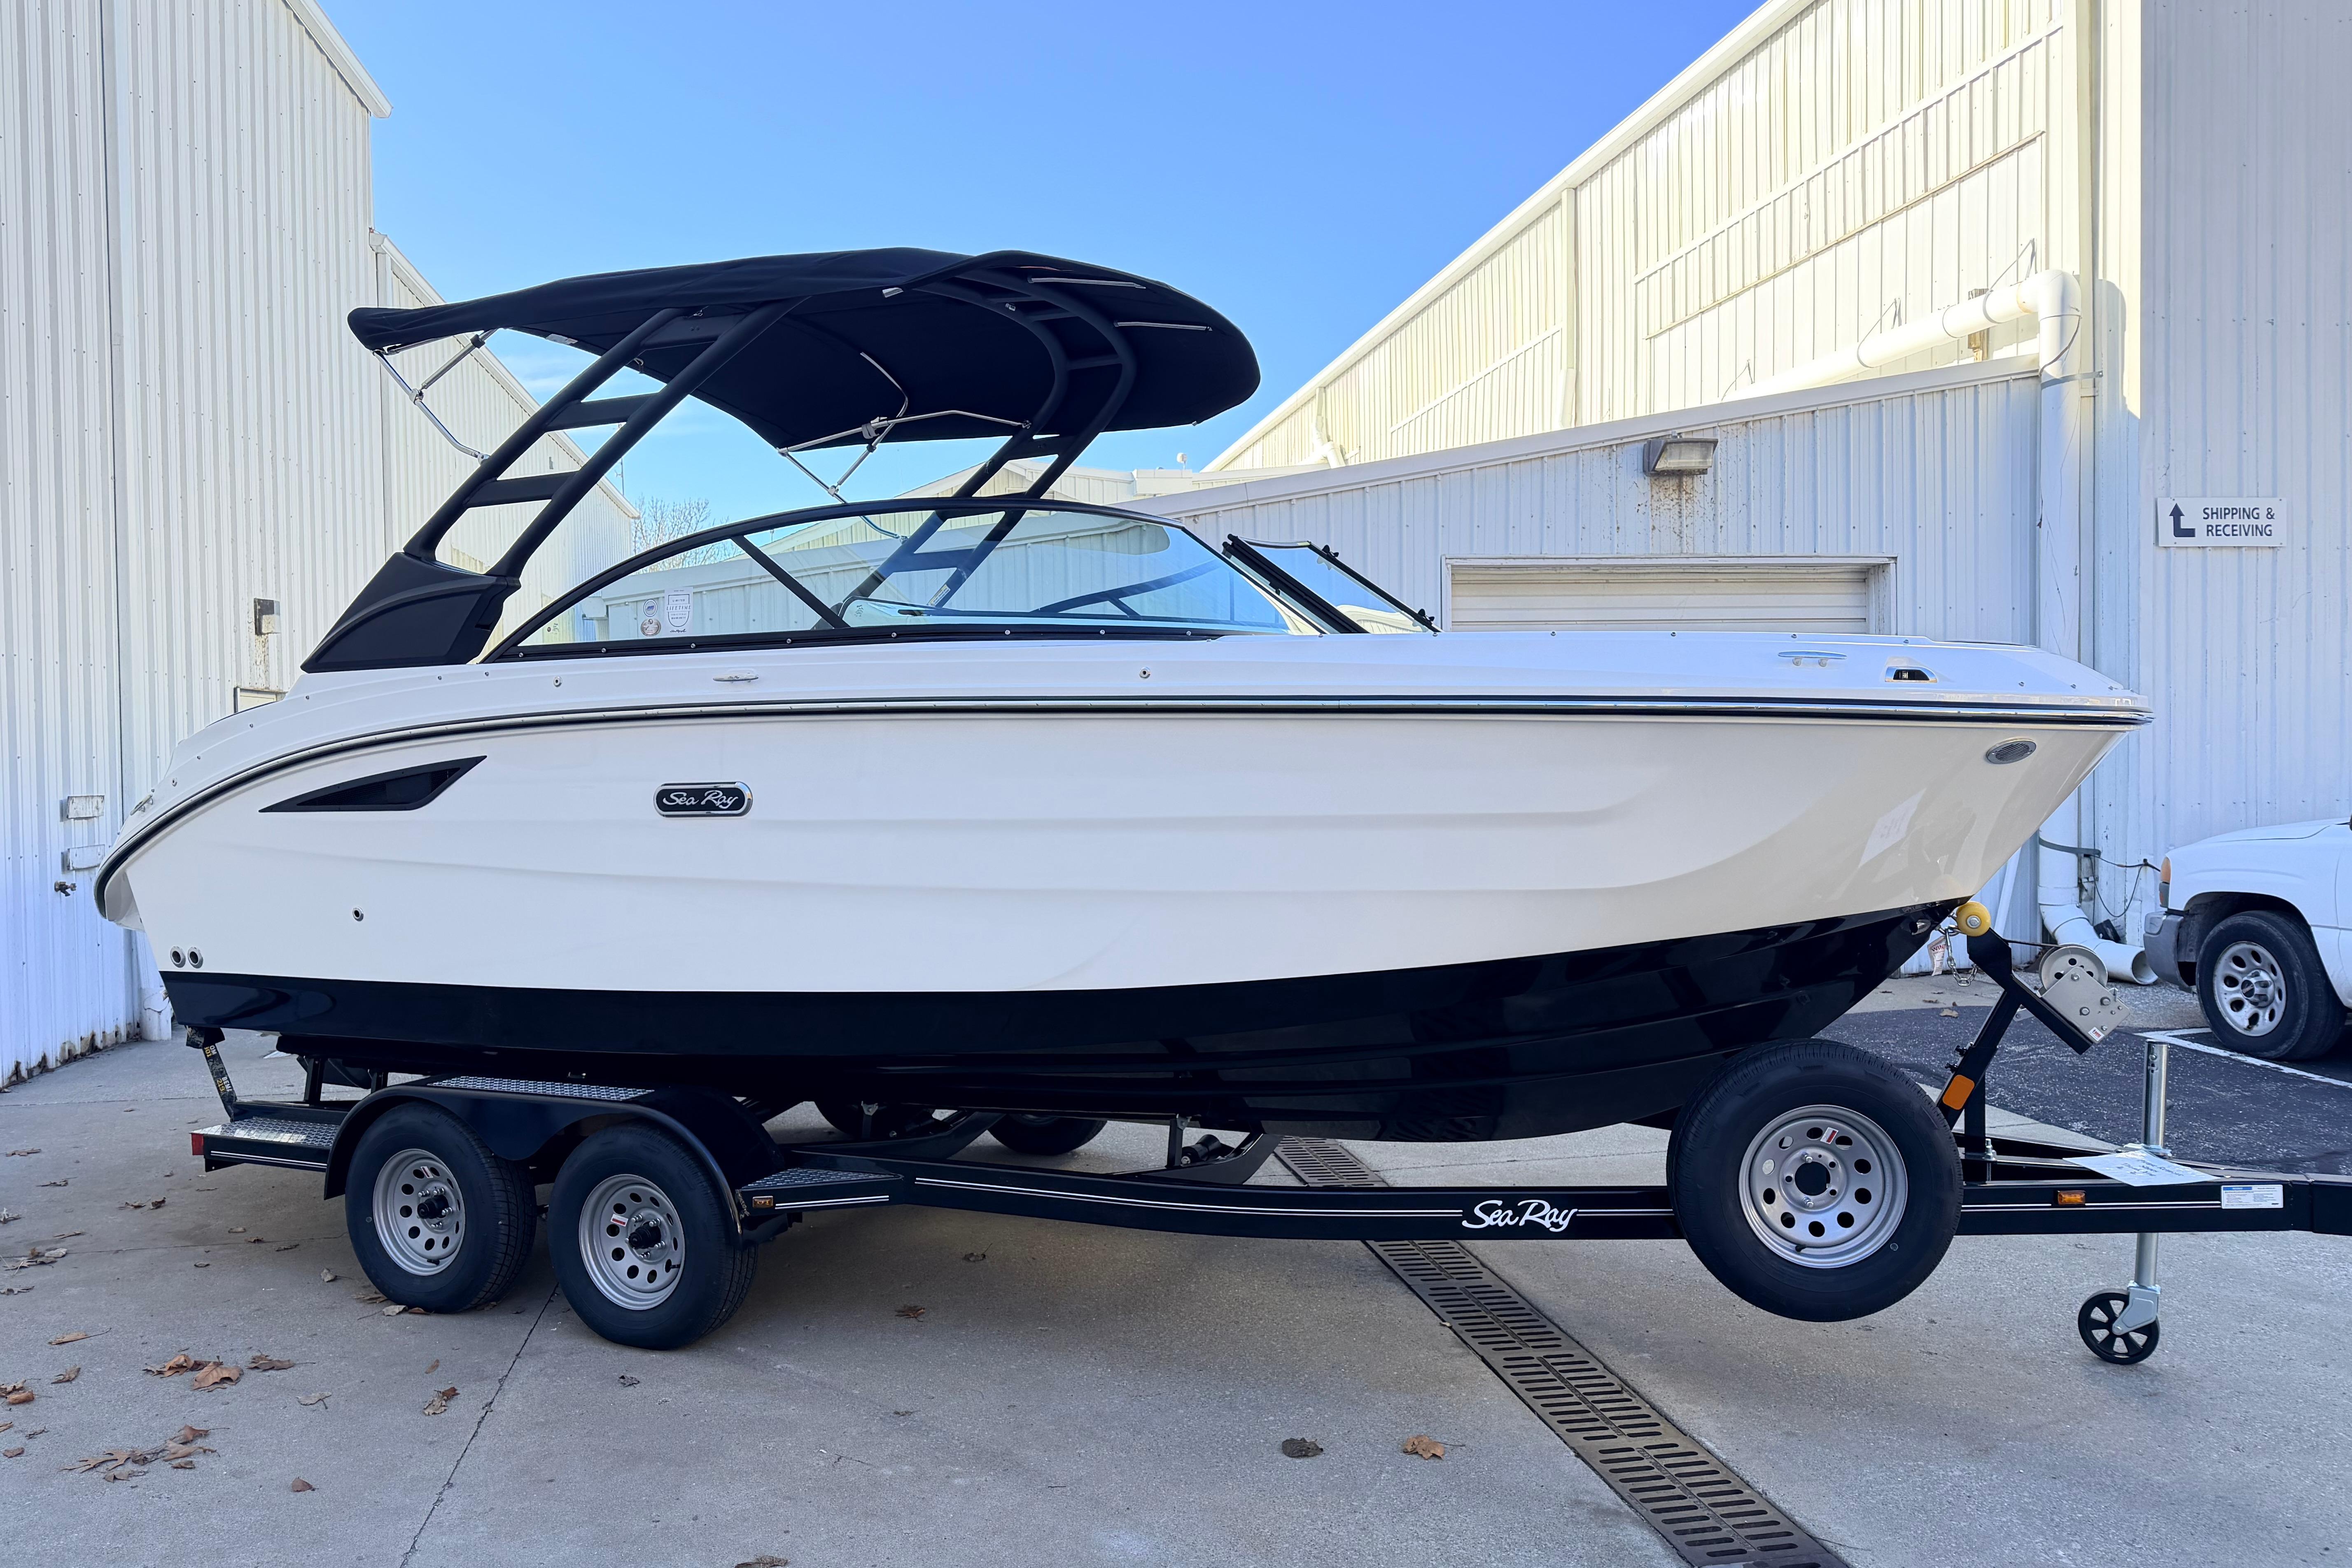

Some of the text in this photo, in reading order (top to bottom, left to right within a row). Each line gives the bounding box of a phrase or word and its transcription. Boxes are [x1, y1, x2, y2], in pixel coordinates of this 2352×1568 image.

[2203, 507, 2275, 520] SHIPPING &
[2206, 524, 2273, 537] RECEIVING
[663, 790, 738, 809] Sea Ray
[1462, 1199, 1577, 1232] Sea Ray
